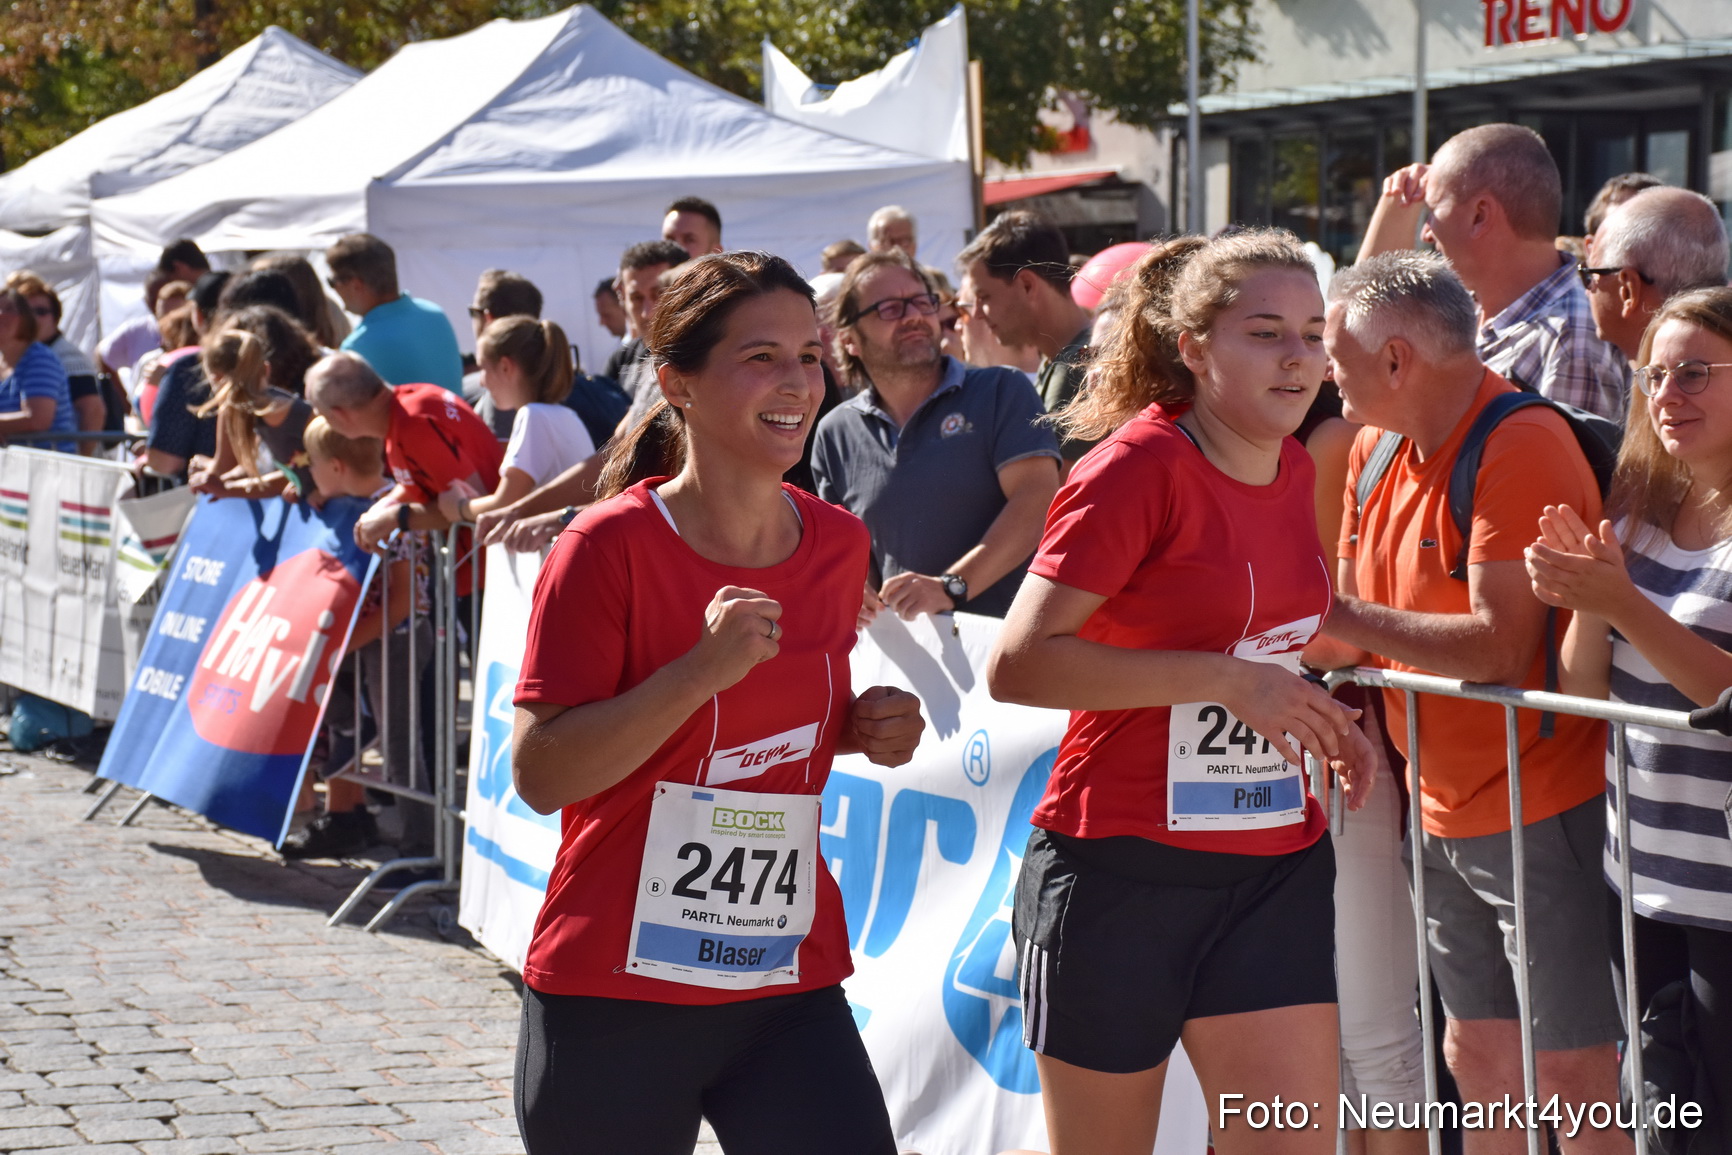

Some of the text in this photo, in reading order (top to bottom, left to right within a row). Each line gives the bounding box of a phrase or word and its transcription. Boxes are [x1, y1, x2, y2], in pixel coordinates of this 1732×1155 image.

[1484, 0, 1633, 46] RENO
[182, 556, 225, 586] STORE
[159, 611, 206, 643] ONLINE
[739, 742, 790, 768] DEHN
[1207, 763, 1280, 775] PARTL Neumarkt
[1234, 786, 1271, 809] Pröll
[712, 807, 785, 831] BOCK
[711, 828, 737, 838] inspired
[739, 830, 747, 839] by
[671, 841, 798, 906] 2474
[682, 908, 774, 927] PARTL Neumarkt
[697, 938, 766, 967] Blaser
